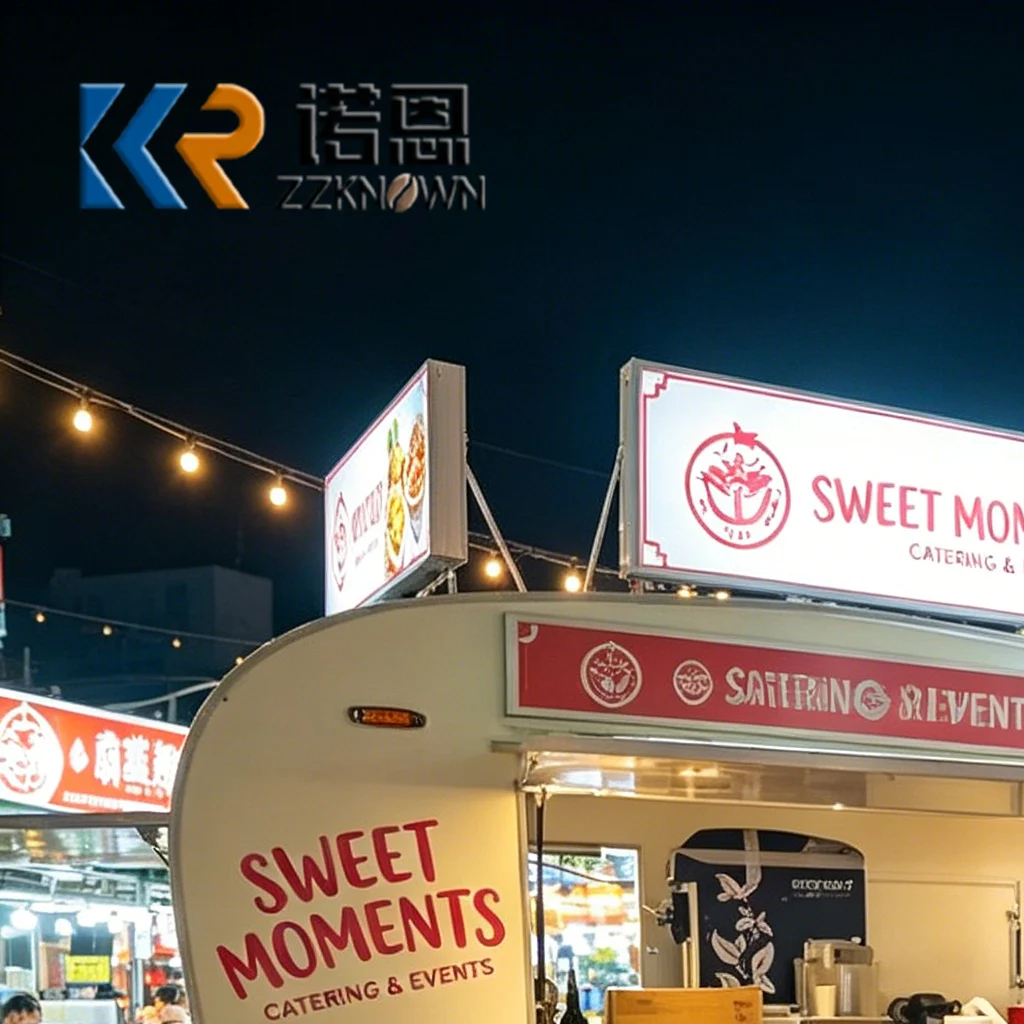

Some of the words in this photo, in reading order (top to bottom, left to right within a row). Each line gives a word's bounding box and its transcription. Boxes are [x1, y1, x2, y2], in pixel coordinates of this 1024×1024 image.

[811, 474, 942, 532] SWEET
[1003, 557, 1015, 574] &
[240, 819, 439, 914] SWEET
[216, 888, 506, 1000] MOMENTS
[264, 980, 380, 1021] CATERING
[387, 976, 403, 995] &
[409, 958, 494, 991] EVENTS
